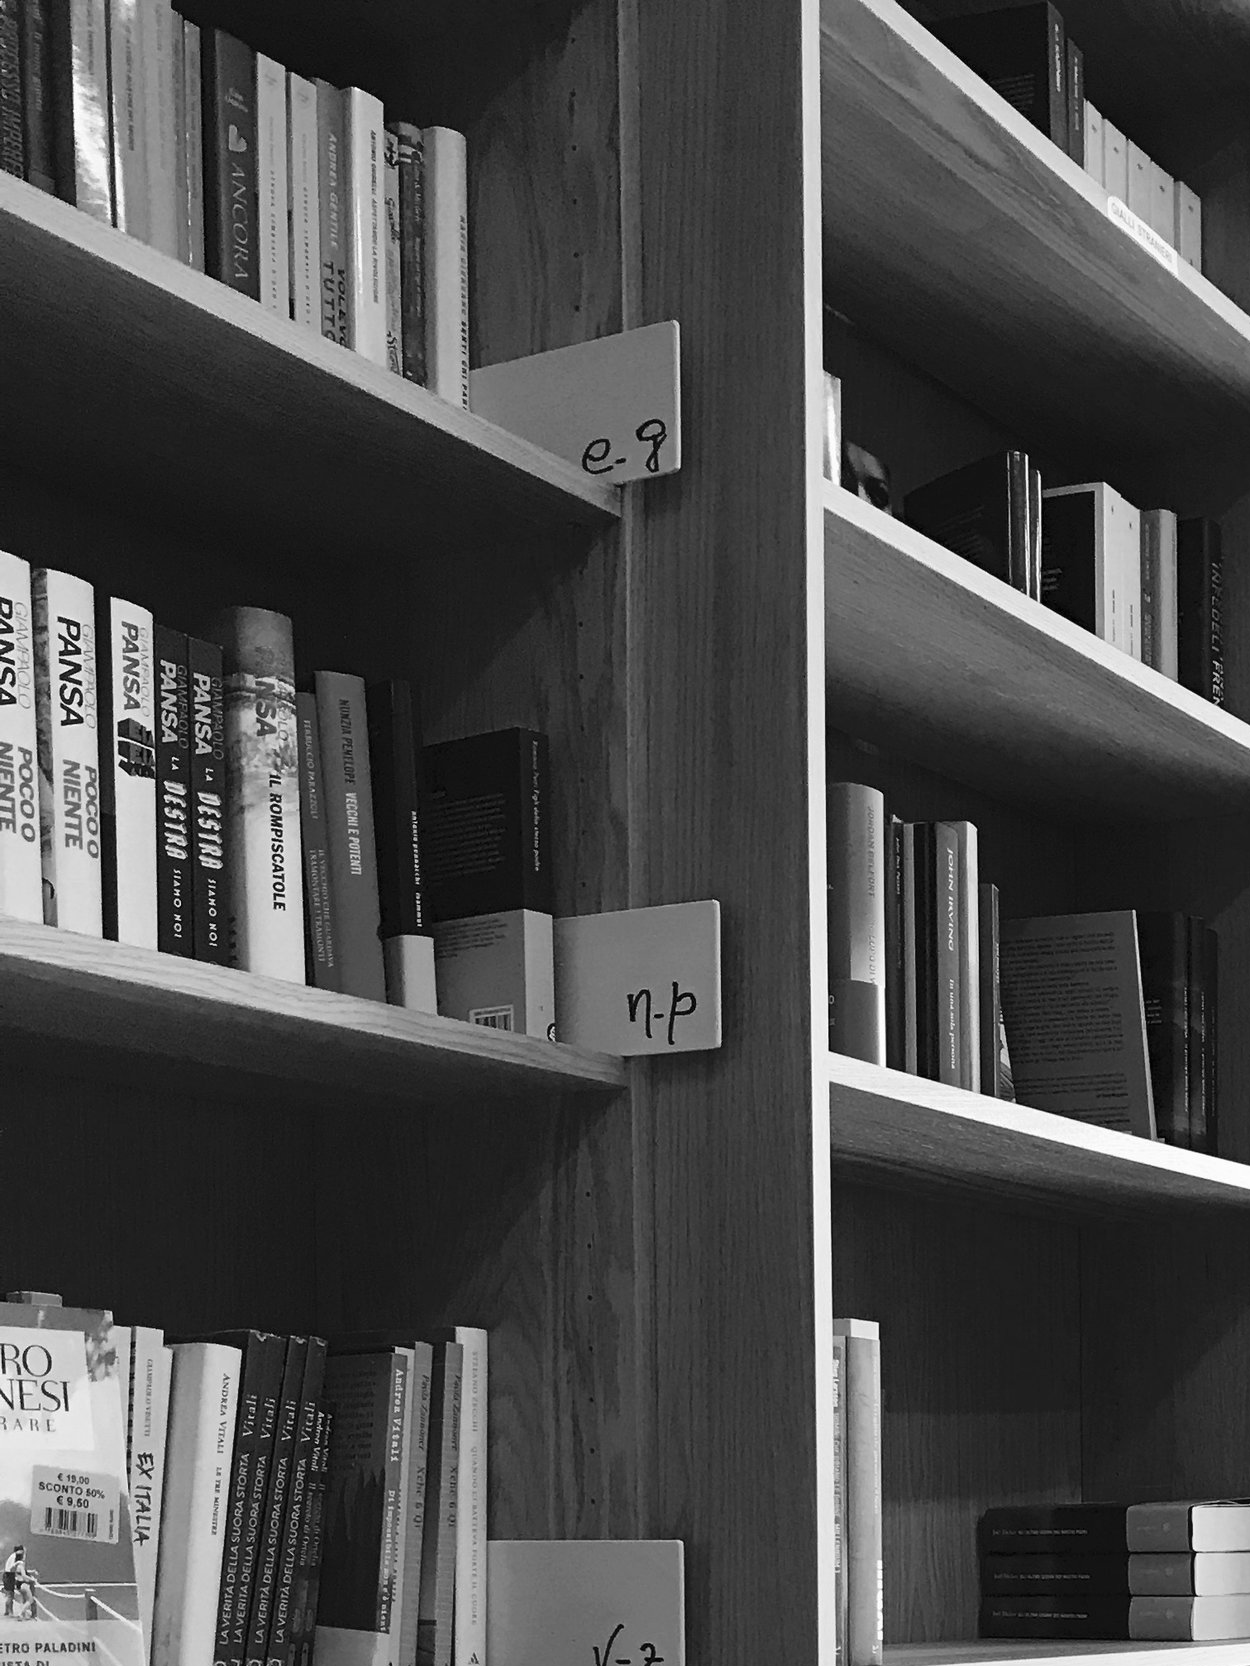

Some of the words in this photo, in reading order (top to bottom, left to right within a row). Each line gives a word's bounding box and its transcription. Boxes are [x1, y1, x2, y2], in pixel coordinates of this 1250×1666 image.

[328, 133, 338, 187] ANDREA
[231, 162, 248, 279] ANCORA
[329, 192, 339, 250] GENTILE
[14, 602, 31, 709] GIAMPAOLO
[57, 616, 84, 726] PANSA
[81, 624, 96, 729] GIAMPAOLO
[121, 621, 141, 711] PANSA
[339, 700, 354, 735] NUNZIA
[172, 757, 179, 771] LA
[270, 773, 281, 787] IL
[343, 736, 356, 785] PENELOPE
[17, 746, 35, 819] POCO
[84, 765, 99, 836] POCO
[62, 759, 83, 850] NIENTE
[164, 780, 188, 861] DESTRA
[346, 793, 359, 826] VECCHI
[21, 826, 36, 843] O
[87, 840, 99, 859] O
[198, 791, 223, 870] DESTRA
[270, 793, 286, 911] ROMPISCATOLE
[348, 837, 361, 875] POTENTI
[947, 848, 955, 890] JOHN
[173, 869, 182, 914] SIAMO
[174, 918, 182, 938] NOI
[947, 896, 955, 951] IRVING
[242, 1394, 257, 1436] Vitali
[261, 1398, 276, 1439] Vitali
[58, 1473, 63, 1481] €
[135, 1452, 154, 1480] EX
[236, 1454, 250, 1498] STORTA
[39, 1482, 83, 1496] SCONTO
[86, 1489, 105, 1499] 50%
[57, 1496, 64, 1505] €
[133, 1485, 151, 1547] ITALIA
[230, 1501, 244, 1542] SUORA
[226, 1545, 239, 1582] DELLA
[220, 1630, 228, 1644] LA
